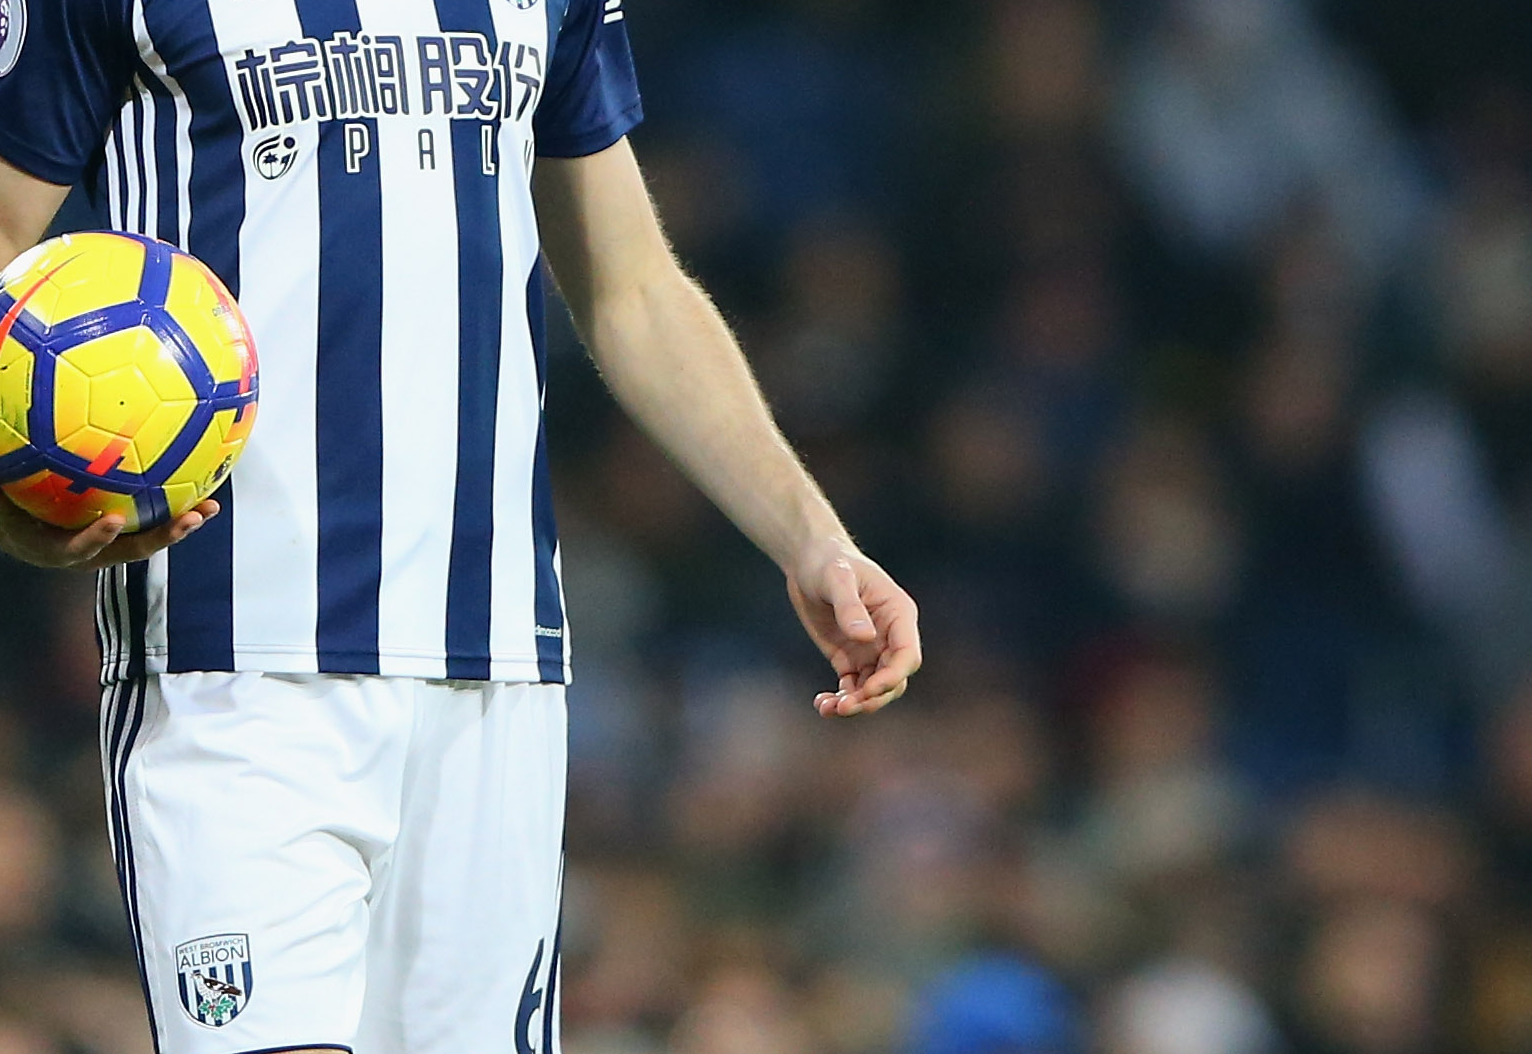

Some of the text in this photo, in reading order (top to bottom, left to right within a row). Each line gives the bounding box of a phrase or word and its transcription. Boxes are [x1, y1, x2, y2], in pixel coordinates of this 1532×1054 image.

[179, 937, 243, 954] WEST BROMWICH
[179, 945, 245, 969] ALBION
